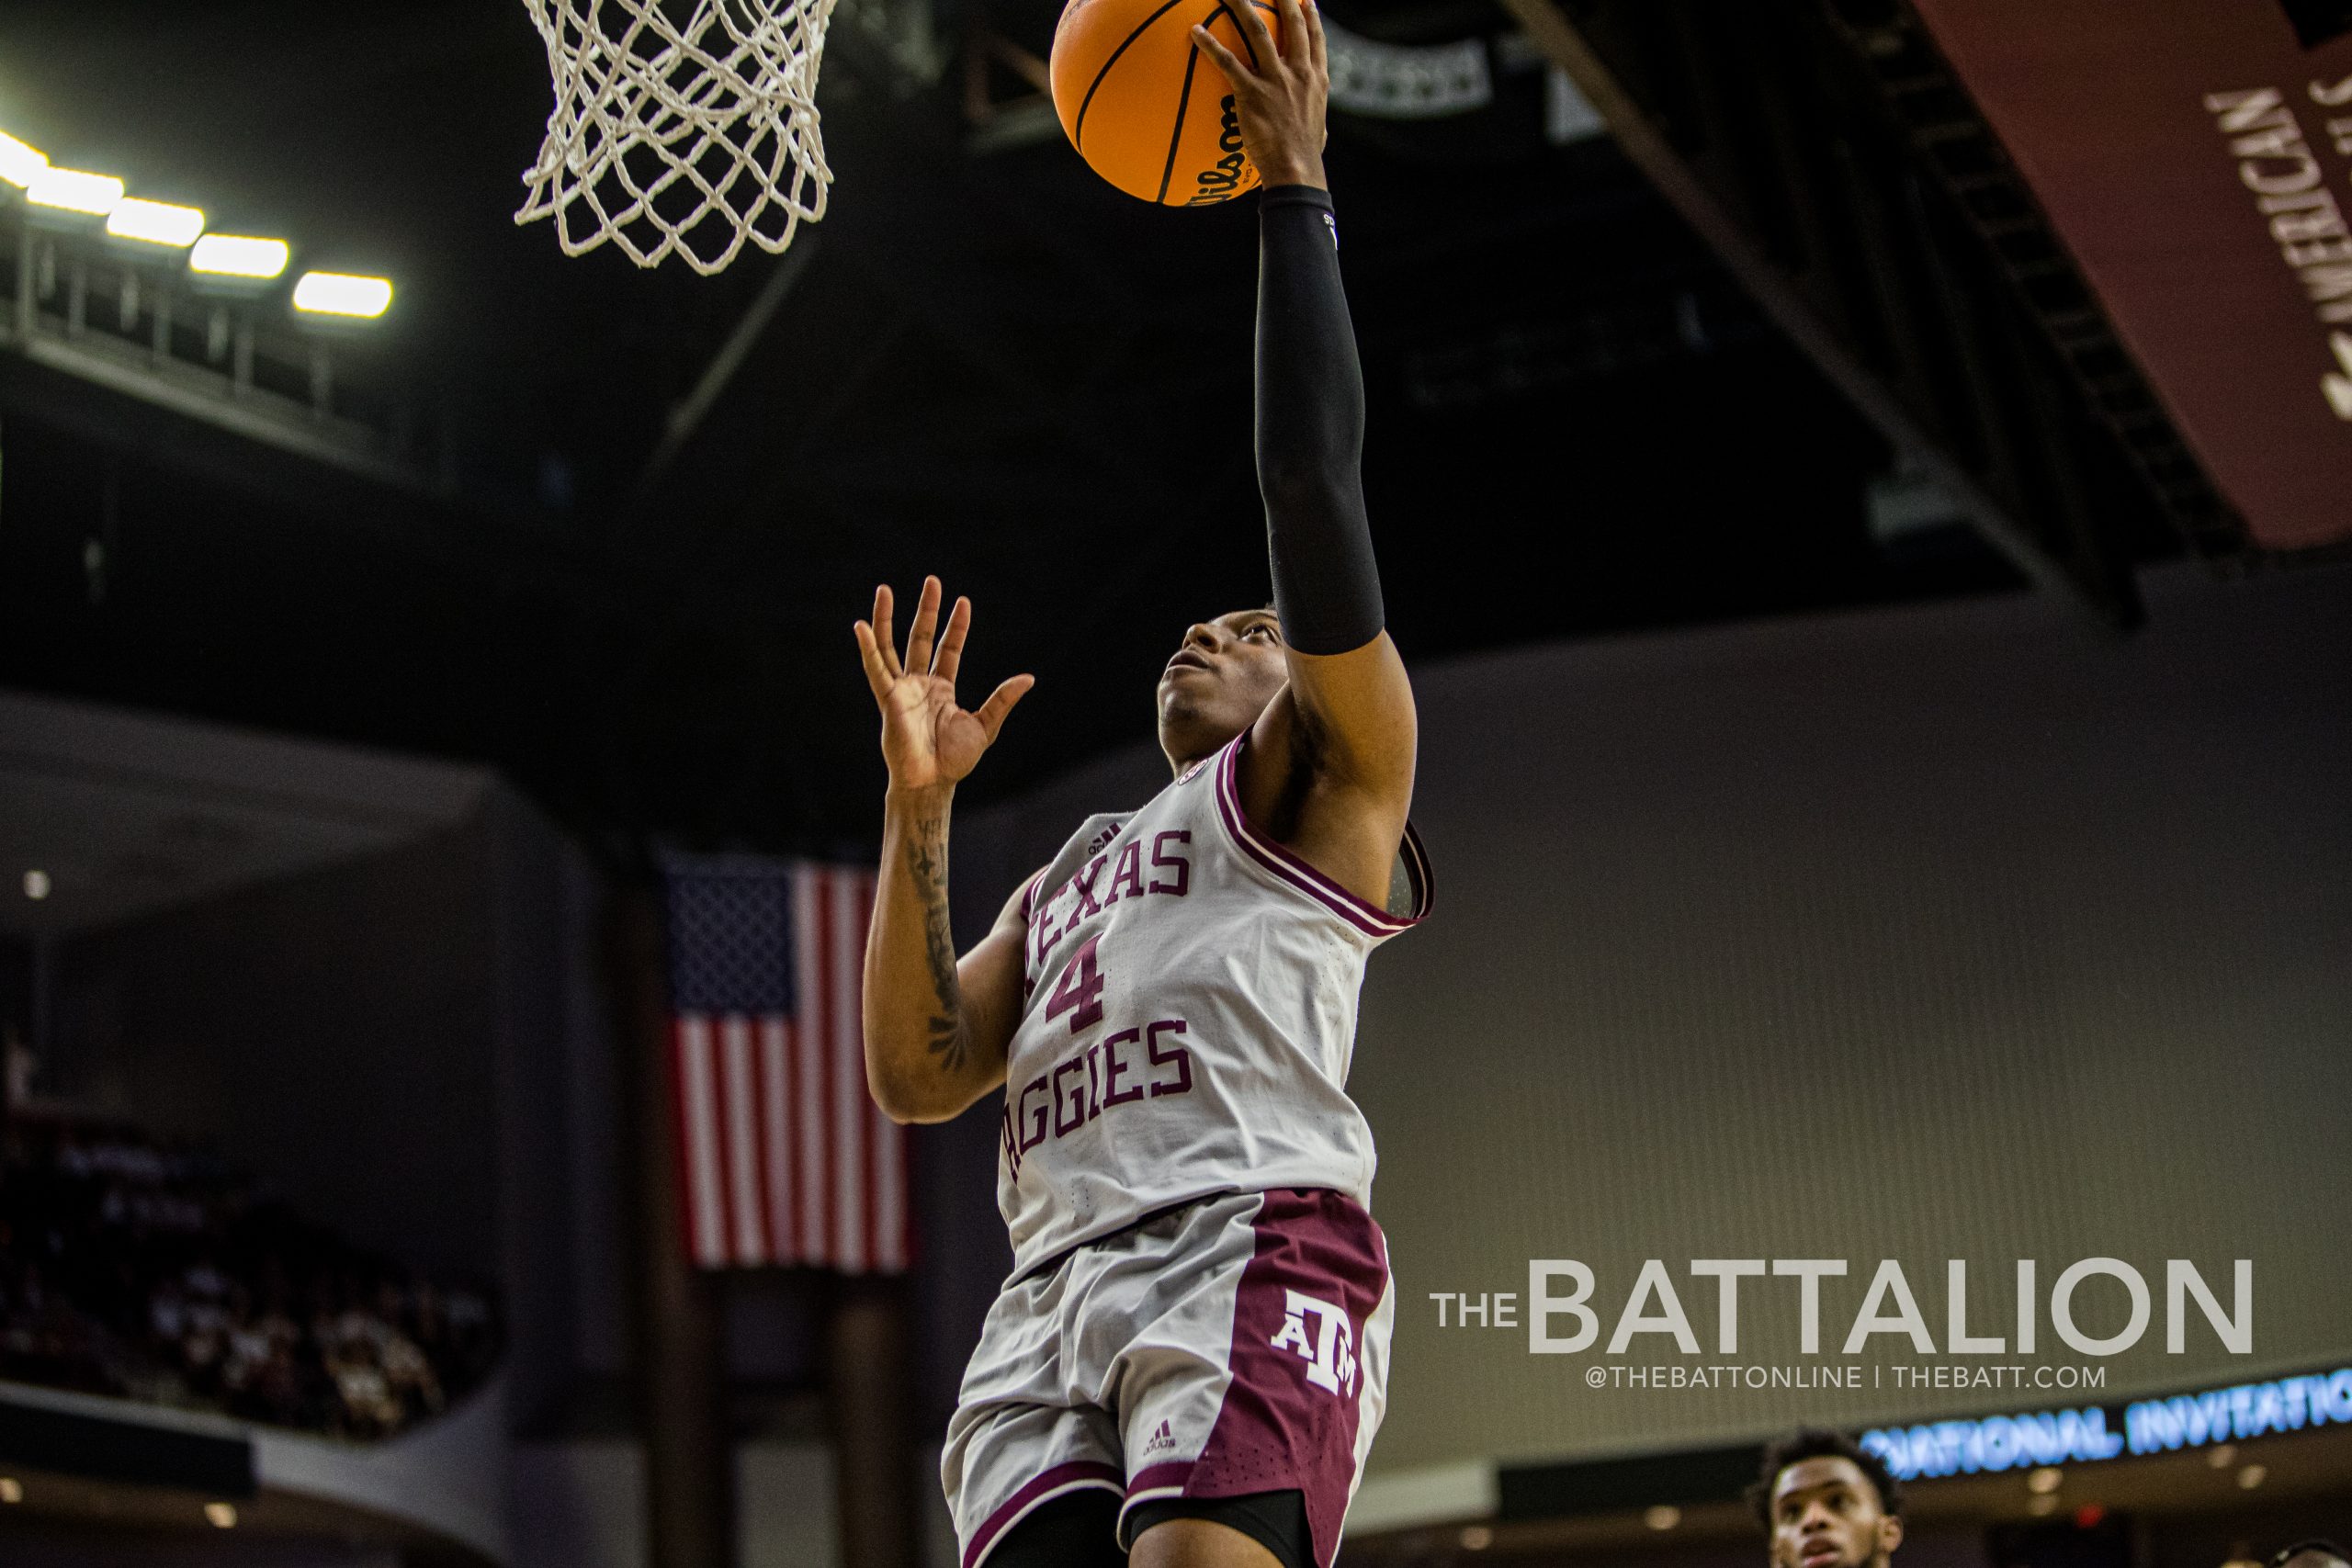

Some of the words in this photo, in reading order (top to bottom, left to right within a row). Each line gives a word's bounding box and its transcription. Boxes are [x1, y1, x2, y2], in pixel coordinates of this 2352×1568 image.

[1046, 932, 1104, 1034] 4
[1003, 1020, 1193, 1185] AGGIES
[1860, 1406, 2124, 1481] NATIONAL
